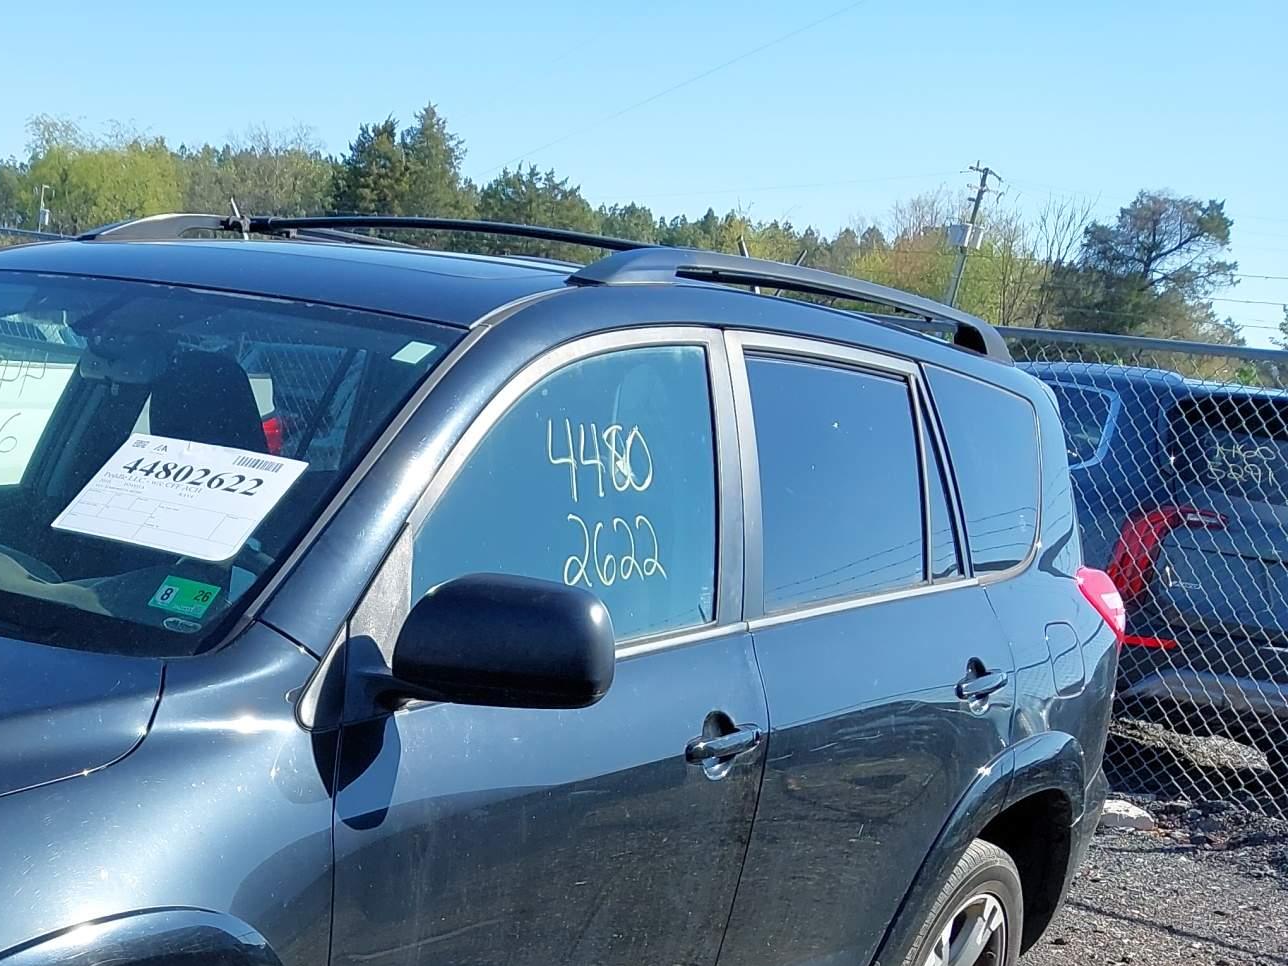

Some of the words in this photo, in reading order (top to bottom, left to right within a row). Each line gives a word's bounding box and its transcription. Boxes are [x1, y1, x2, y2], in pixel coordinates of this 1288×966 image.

[122, 457, 264, 496] 44802622
[548, 418, 653, 502] 4480
[564, 513, 668, 587] 2622
[160, 587, 174, 601] 8
[193, 590, 212, 602] 26
